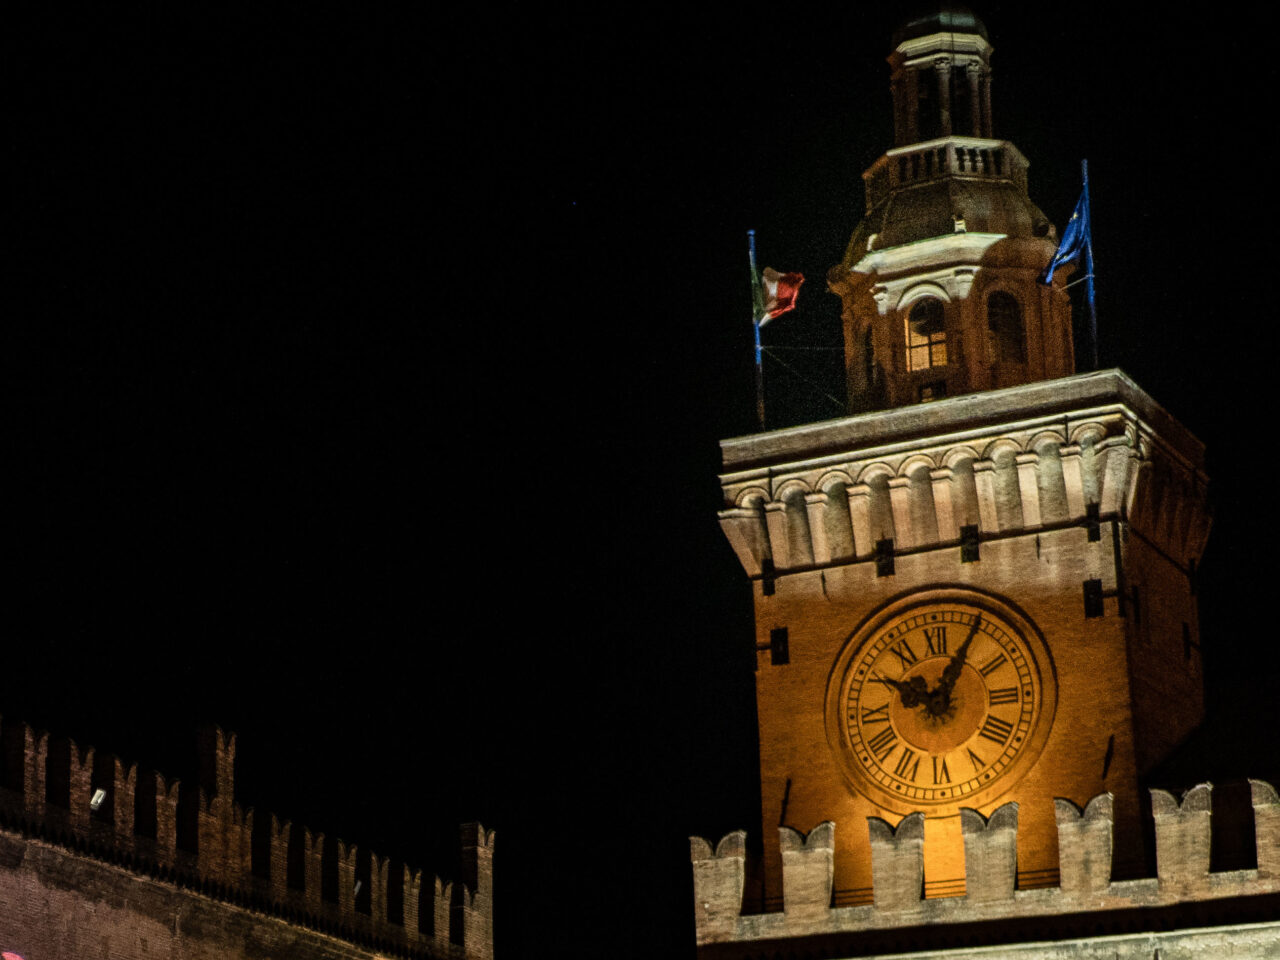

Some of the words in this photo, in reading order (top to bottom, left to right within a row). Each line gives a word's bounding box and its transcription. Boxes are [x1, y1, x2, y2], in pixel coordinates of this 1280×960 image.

[923, 626, 947, 656] XII
[989, 686, 1019, 707] III
[932, 756, 951, 785] VI
